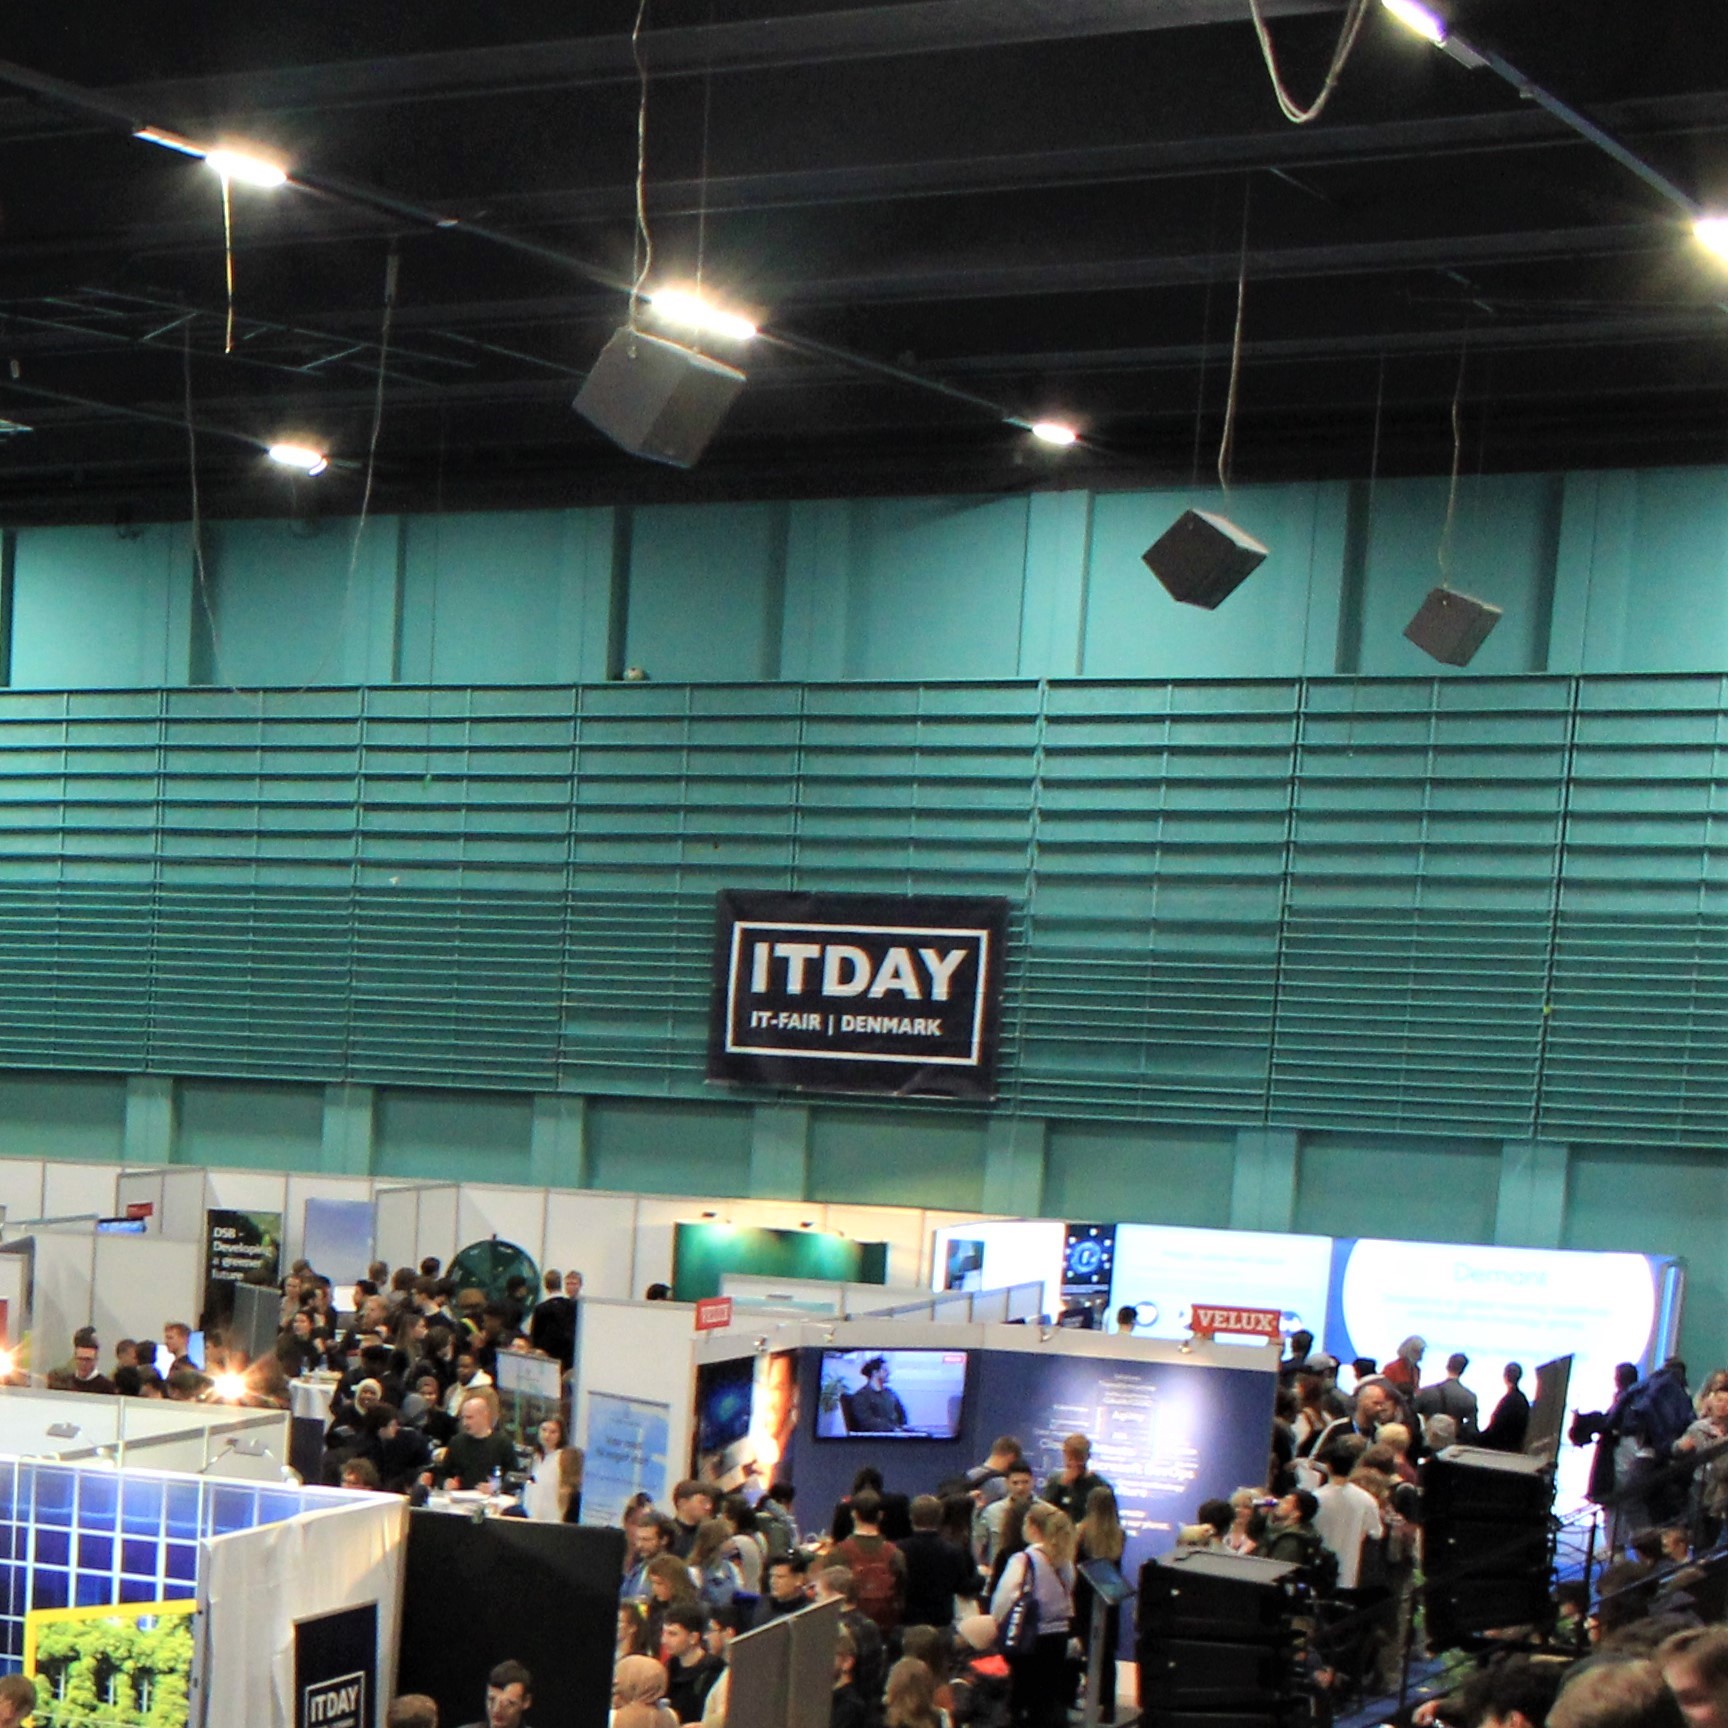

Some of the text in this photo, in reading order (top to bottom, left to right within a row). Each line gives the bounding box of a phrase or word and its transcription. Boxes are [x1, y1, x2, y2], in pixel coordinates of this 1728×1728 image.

[751, 942, 968, 1000] ITDAY
[750, 1010, 821, 1030] IT-FAIR
[841, 1015, 942, 1036] DENMARK
[213, 1241, 272, 1257] Developing
[1197, 1308, 1274, 1332] VELUX
